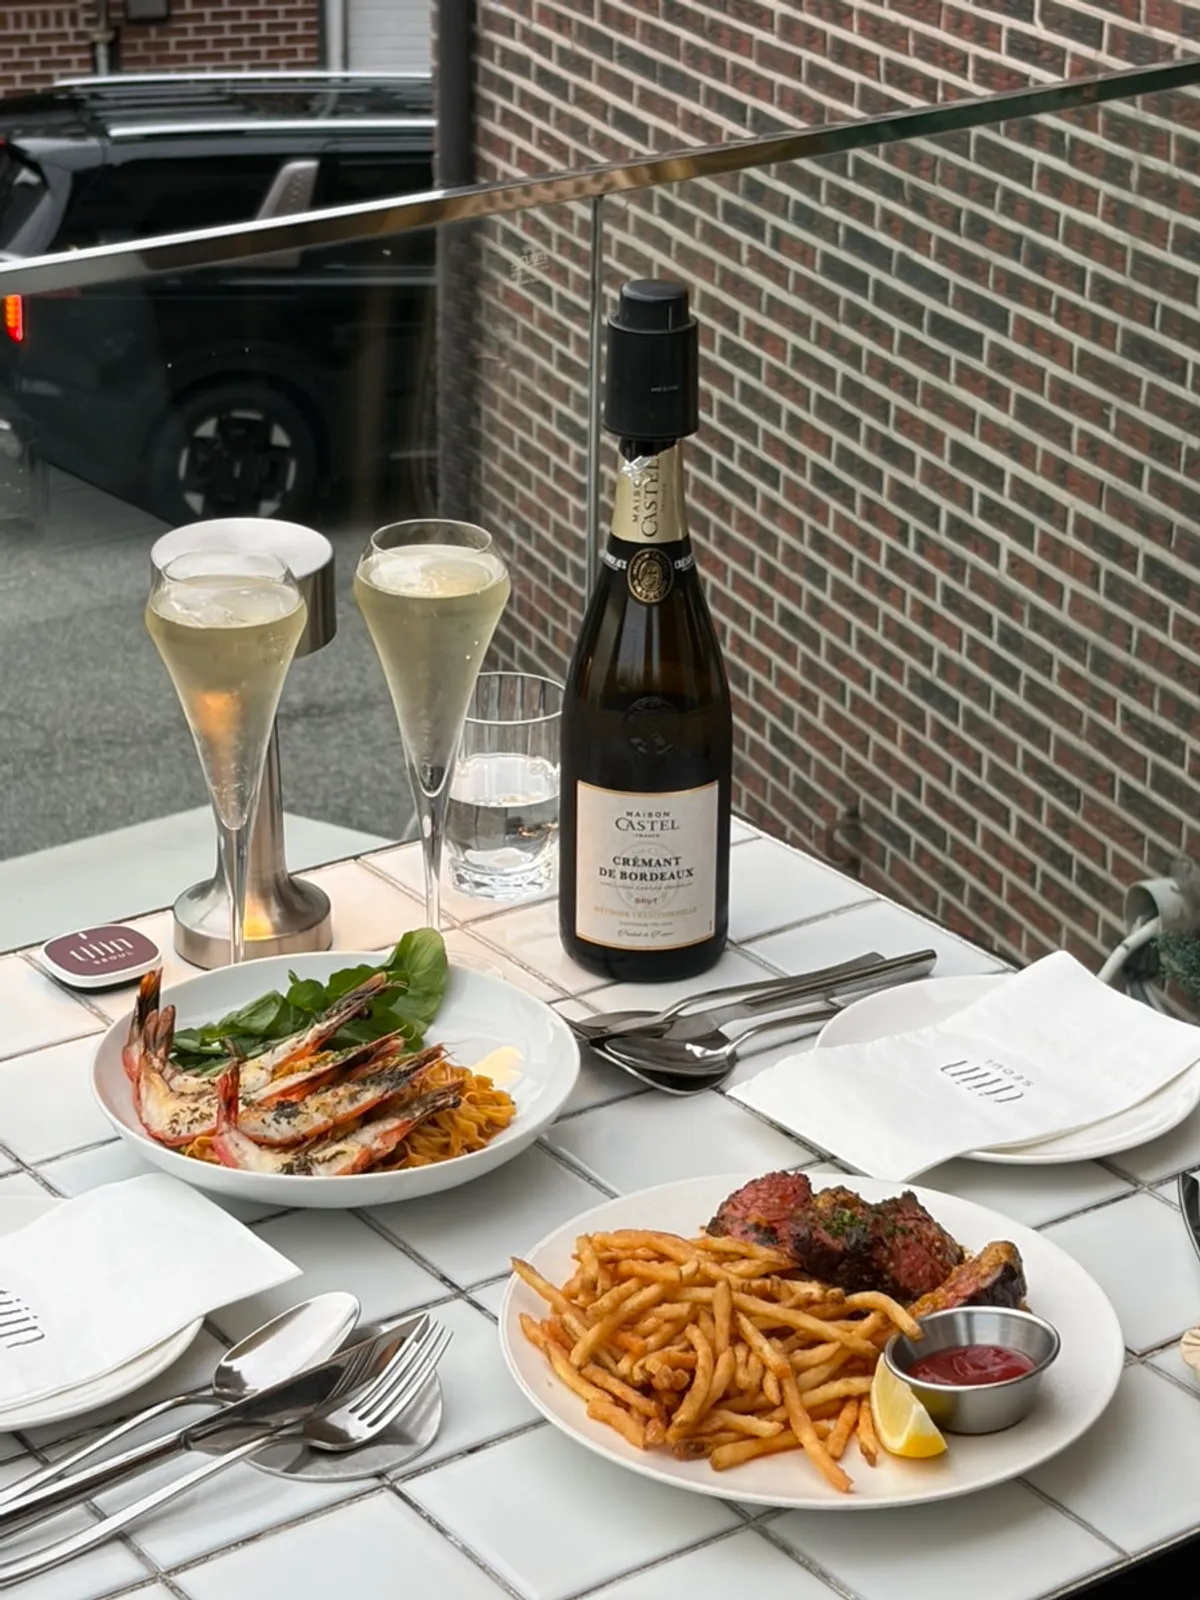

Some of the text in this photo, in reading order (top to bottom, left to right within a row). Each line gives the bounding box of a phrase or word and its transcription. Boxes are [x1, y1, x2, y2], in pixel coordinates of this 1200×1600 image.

[632, 479, 642, 523] MAISO
[641, 457, 660, 537] CASTEL
[615, 817, 680, 831] CASTEL
[612, 855, 682, 868] CRÉMANT
[599, 867, 695, 882] DE BORDEAUX
[634, 897, 658, 905] BRUT
[985, 1059, 1034, 1087] SEOUL
